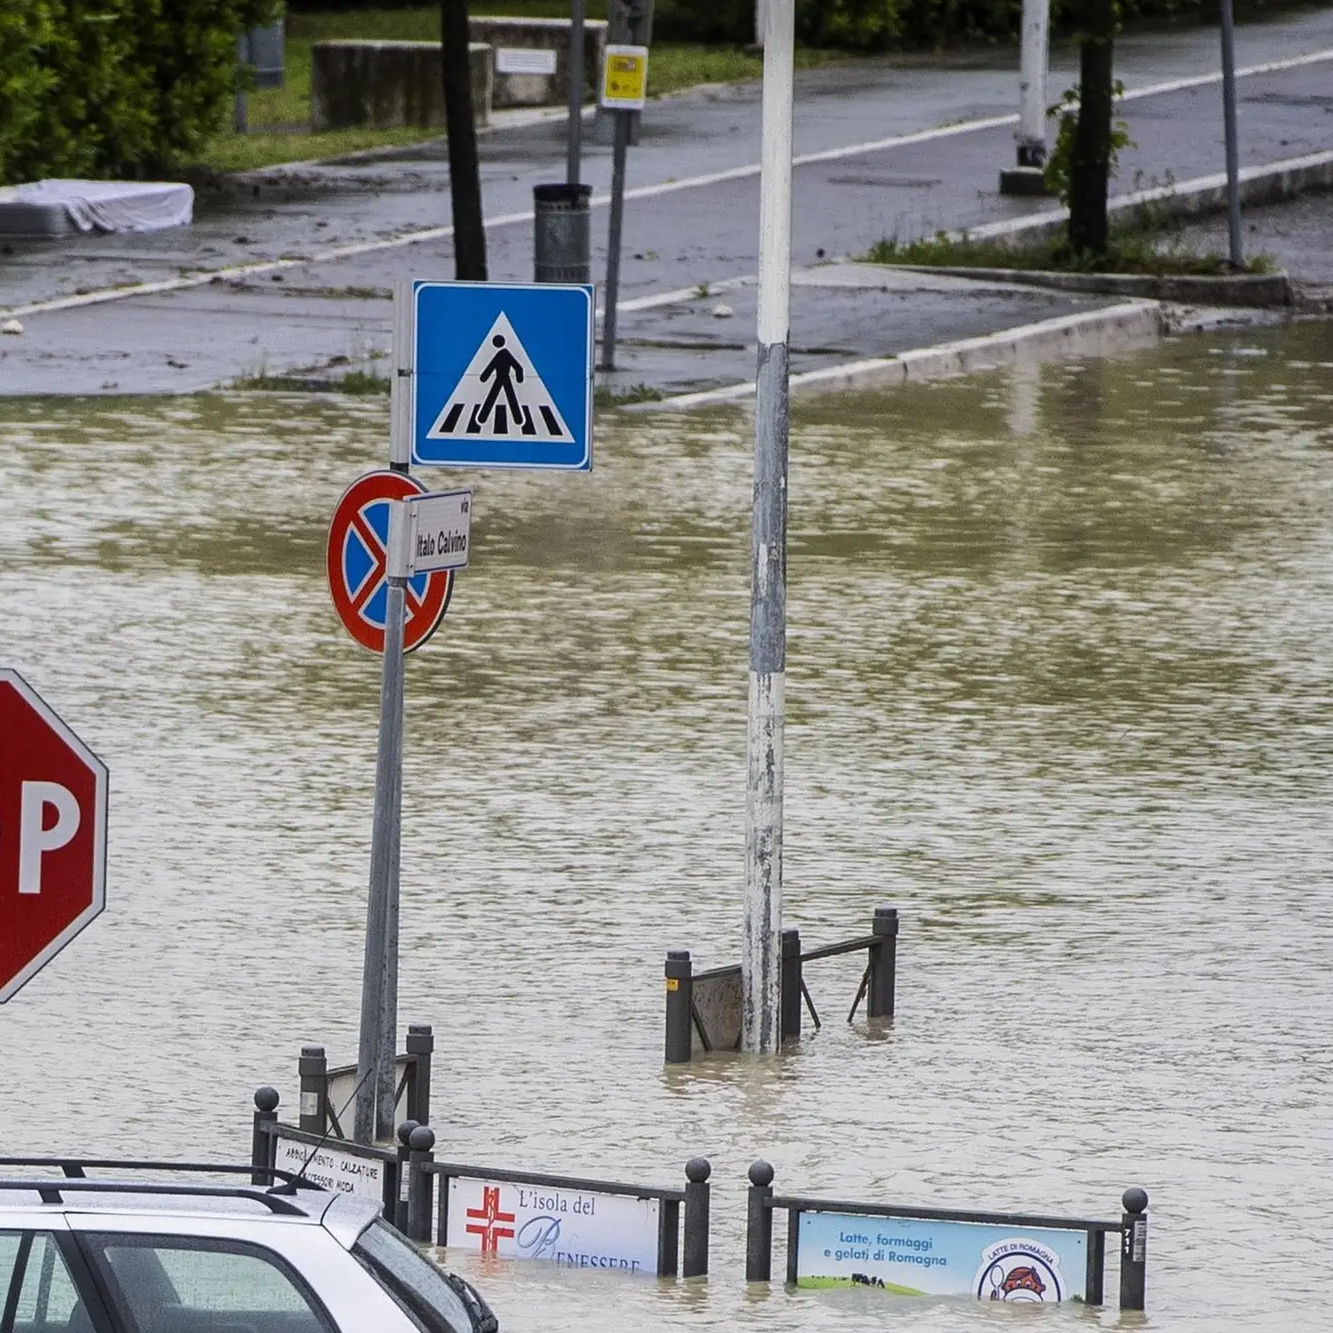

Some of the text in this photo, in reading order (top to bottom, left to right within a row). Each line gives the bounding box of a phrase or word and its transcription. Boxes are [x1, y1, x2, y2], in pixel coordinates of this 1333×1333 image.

[417, 530, 466, 557] Italo Calvino
[340, 1160, 379, 1180] CALZATURE
[336, 1180, 355, 1194] MODA
[519, 1189, 595, 1215] L'isola del
[839, 1231, 933, 1252] Latte, formaggi
[823, 1247, 947, 1268] e gelati di Romagna
[988, 1242, 1054, 1265] LATTE DI ROMAGNA
